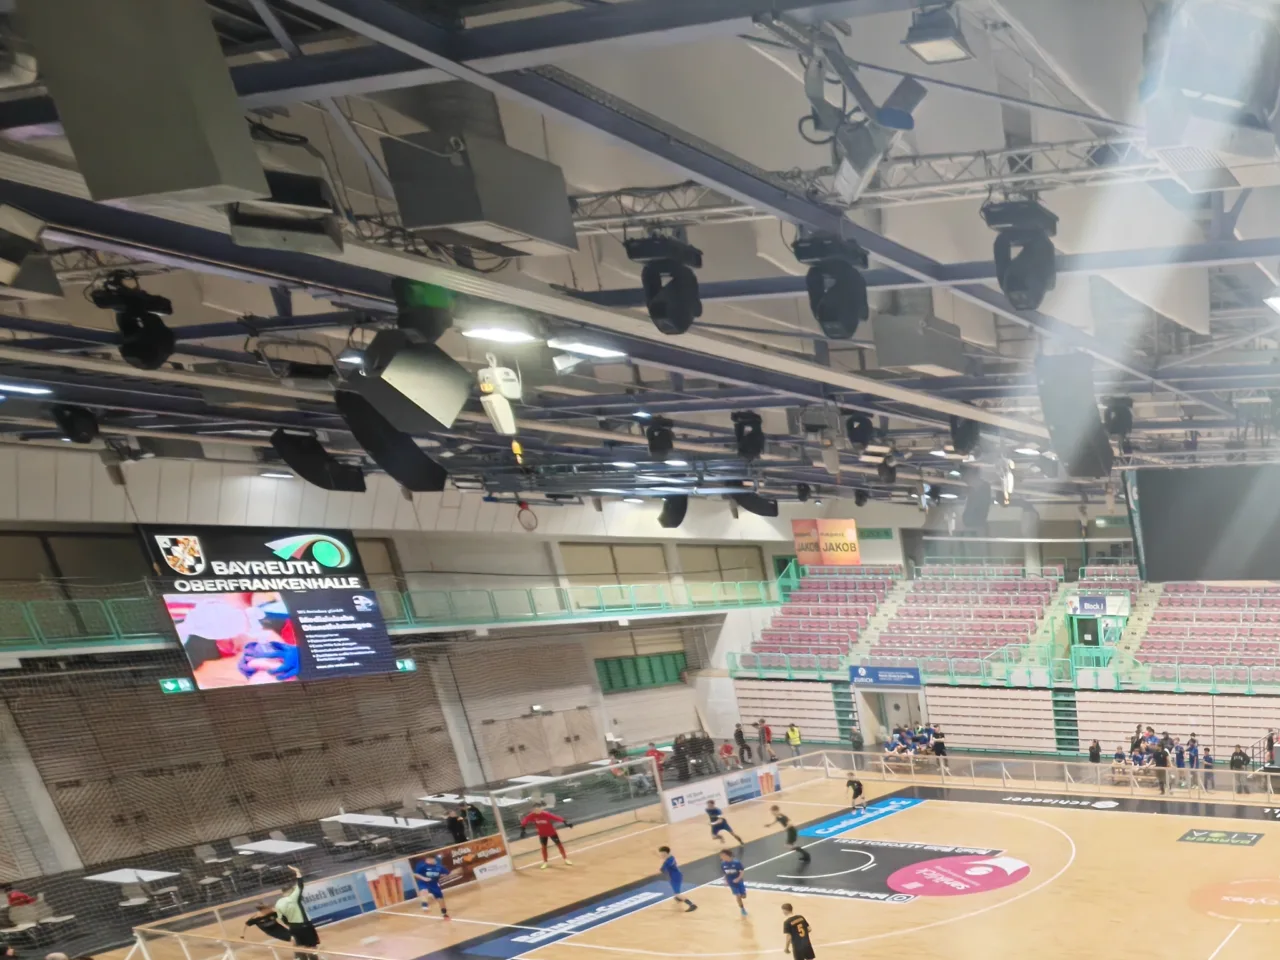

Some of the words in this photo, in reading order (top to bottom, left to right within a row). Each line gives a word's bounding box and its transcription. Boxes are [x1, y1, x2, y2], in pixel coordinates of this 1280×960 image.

[822, 542, 857, 552] JAKOB
[211, 561, 321, 576] BAYREUTH
[174, 577, 361, 592] OBERFRANKENHALLE
[1185, 835, 1252, 845] BARMER
[1221, 895, 1280, 905] cybex
[797, 923, 806, 938] 5
